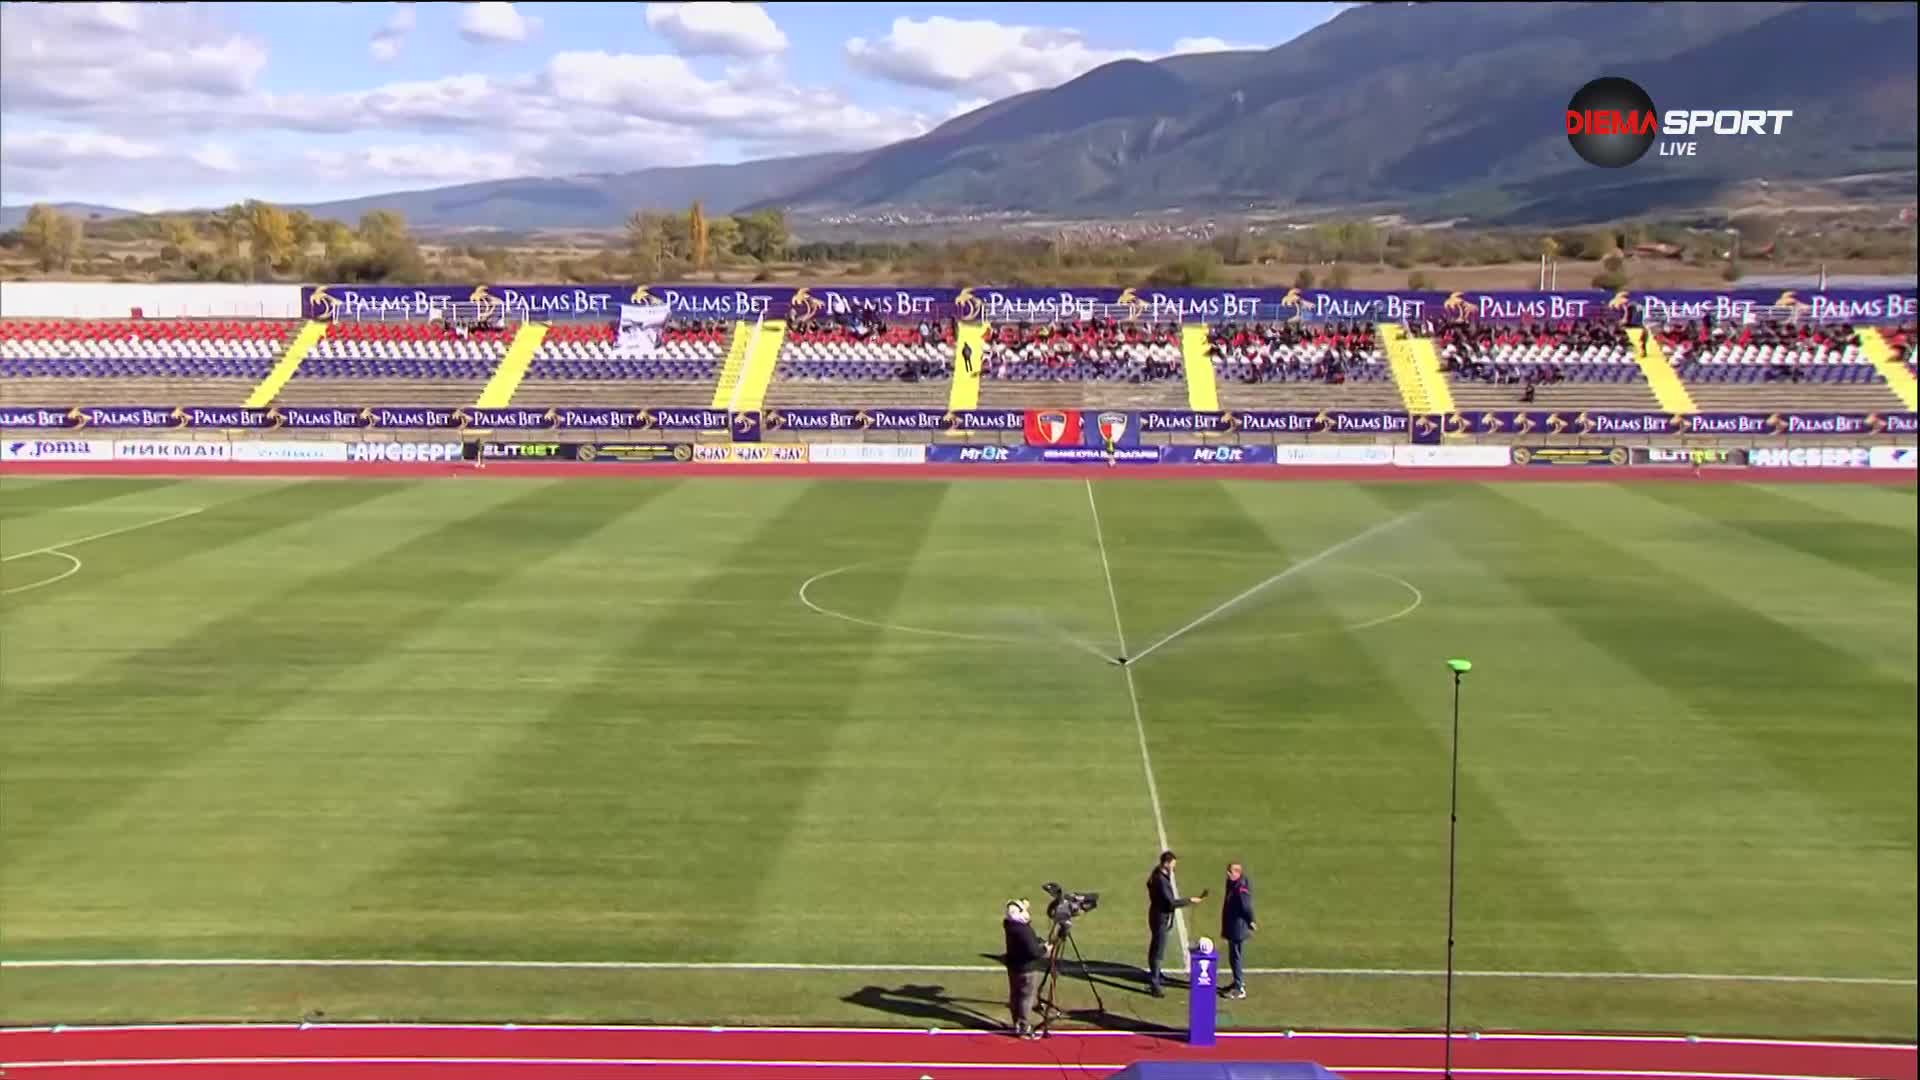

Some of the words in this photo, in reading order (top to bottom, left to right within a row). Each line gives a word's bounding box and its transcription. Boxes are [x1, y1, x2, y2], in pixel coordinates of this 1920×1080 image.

[344, 291, 410, 313] PALMS
[414, 291, 452, 313] BET
[503, 290, 568, 313] PALMS
[574, 290, 612, 312] BET
[664, 291, 731, 313] PALMS
[735, 291, 773, 313] BET
[895, 291, 936, 314] BET
[989, 293, 1055, 316] PALMS
[1060, 293, 1098, 316] BET
[1151, 293, 1219, 316] PALMS
[1223, 293, 1262, 316] BET
[1386, 295, 1425, 318] BET
[1479, 295, 1546, 318] PALMS
[1550, 295, 1590, 318] BET
[1716, 295, 1756, 319] BET
[1812, 295, 1884, 318] PALMS
[0, 413, 35, 425] ALMS
[38, 410, 66, 425] BET
[93, 410, 140, 424] PALMS
[143, 410, 169, 424] BET
[194, 410, 238, 424] PALMS
[241, 411, 266, 424] BET
[287, 411, 331, 424] PALMS
[333, 411, 357, 424] BET
[381, 411, 424, 425] PALMS
[426, 411, 450, 425] BET
[474, 411, 516, 425] PALMS
[518, 411, 543, 425] BET
[566, 411, 609, 426] PALMS
[610, 411, 635, 426] BET
[658, 412, 701, 426] PALMS
[703, 411, 727, 426] BET
[787, 413, 828, 426] PALMS
[830, 413, 854, 426] BET
[875, 413, 917, 427] PALMS
[918, 413, 941, 427] BET
[964, 413, 1005, 427] PALMS
[1007, 413, 1024, 427] BE
[1149, 413, 1192, 428] PALMS
[1194, 413, 1220, 428] BET
[1243, 414, 1286, 429] PALMS
[1289, 414, 1314, 429] BET
[1337, 415, 1381, 429] PALMS
[1383, 415, 1408, 429] BET
[1597, 416, 1641, 431] PALMS
[1643, 416, 1668, 430] BET
[1692, 416, 1738, 431] PALMS
[1738, 416, 1764, 431] BET
[1788, 416, 1835, 431] PALMS
[1836, 416, 1863, 431] BET
[122, 445, 223, 456] НИКМАН
